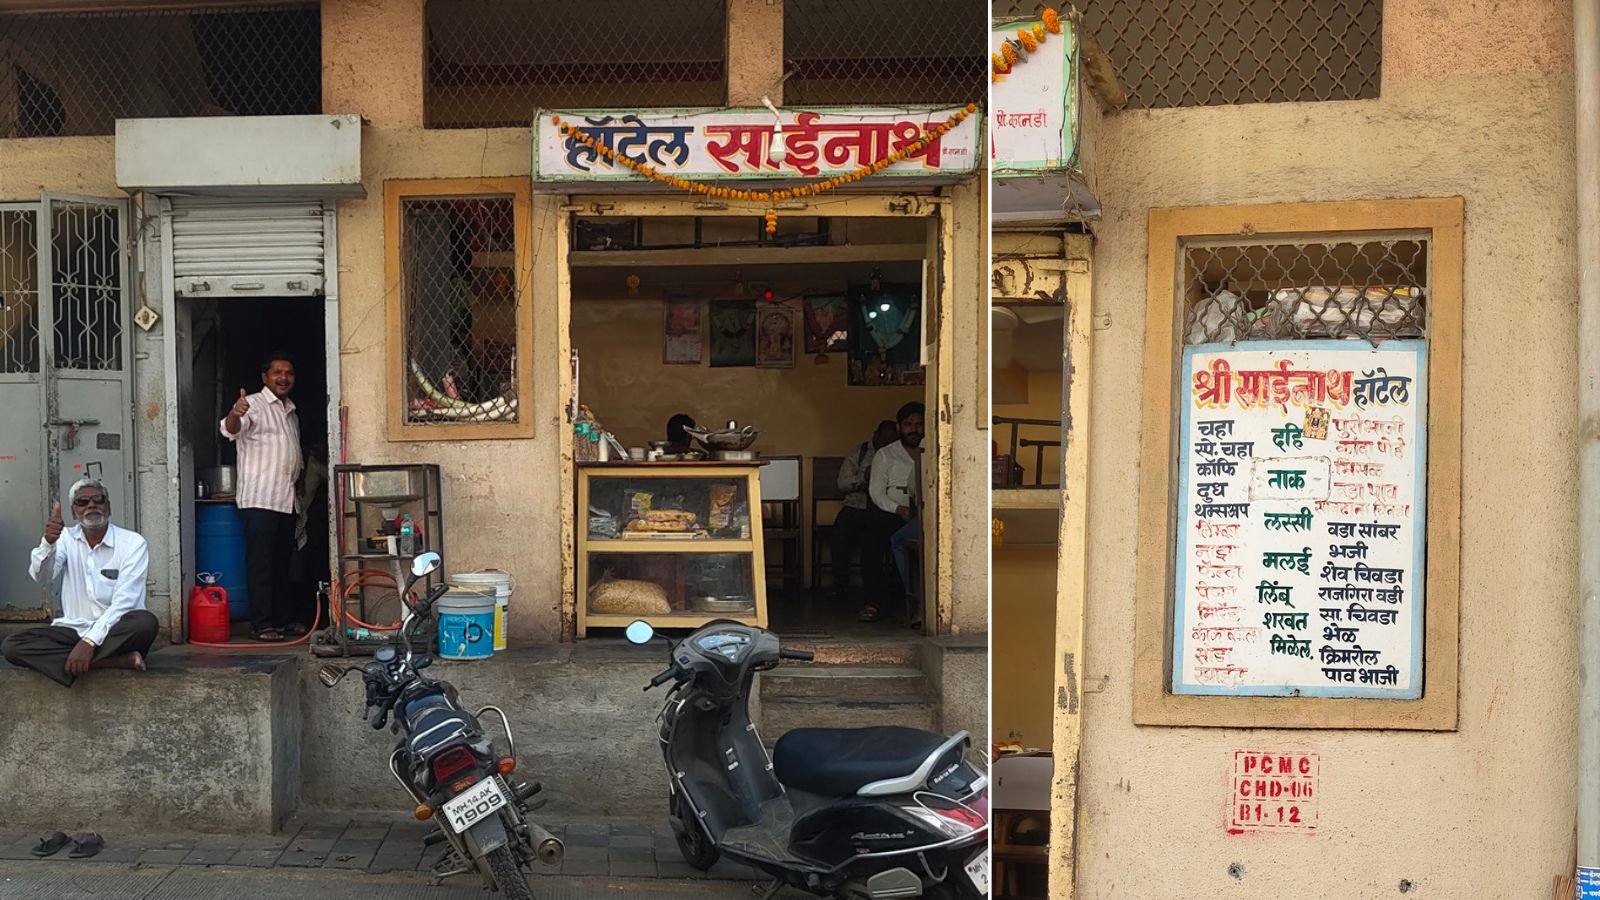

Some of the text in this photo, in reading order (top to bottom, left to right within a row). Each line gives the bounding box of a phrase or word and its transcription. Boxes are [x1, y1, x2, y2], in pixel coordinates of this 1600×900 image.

[561, 112, 943, 176] हॉटेल साईनाथ
[1192, 358, 1412, 416] श्री साईनाथ हॉटेल
[1197, 419, 1235, 438] चहा
[1271, 422, 1304, 453] दहि
[1221, 442, 1255, 459] चहा
[1196, 459, 1239, 478] कॉफि
[1267, 469, 1307, 491] ताक
[1196, 481, 1229, 503] दुध
[1263, 506, 1314, 533] लस्सी
[1327, 519, 1401, 540] वडा सांबर
[1262, 547, 1313, 576] मलई
[1328, 543, 1369, 560] भजी
[1319, 561, 1405, 585] शेव चिवडा
[1318, 584, 1405, 605] राजगिरा वडी
[1346, 603, 1399, 626] चिवडा
[1322, 624, 1360, 644] भेळ
[1319, 645, 1382, 666] क्रिमरोल
[1322, 666, 1400, 686] पाव भाजी
[1243, 755, 1311, 774] PCMC
[455, 793, 502, 826] 1909
